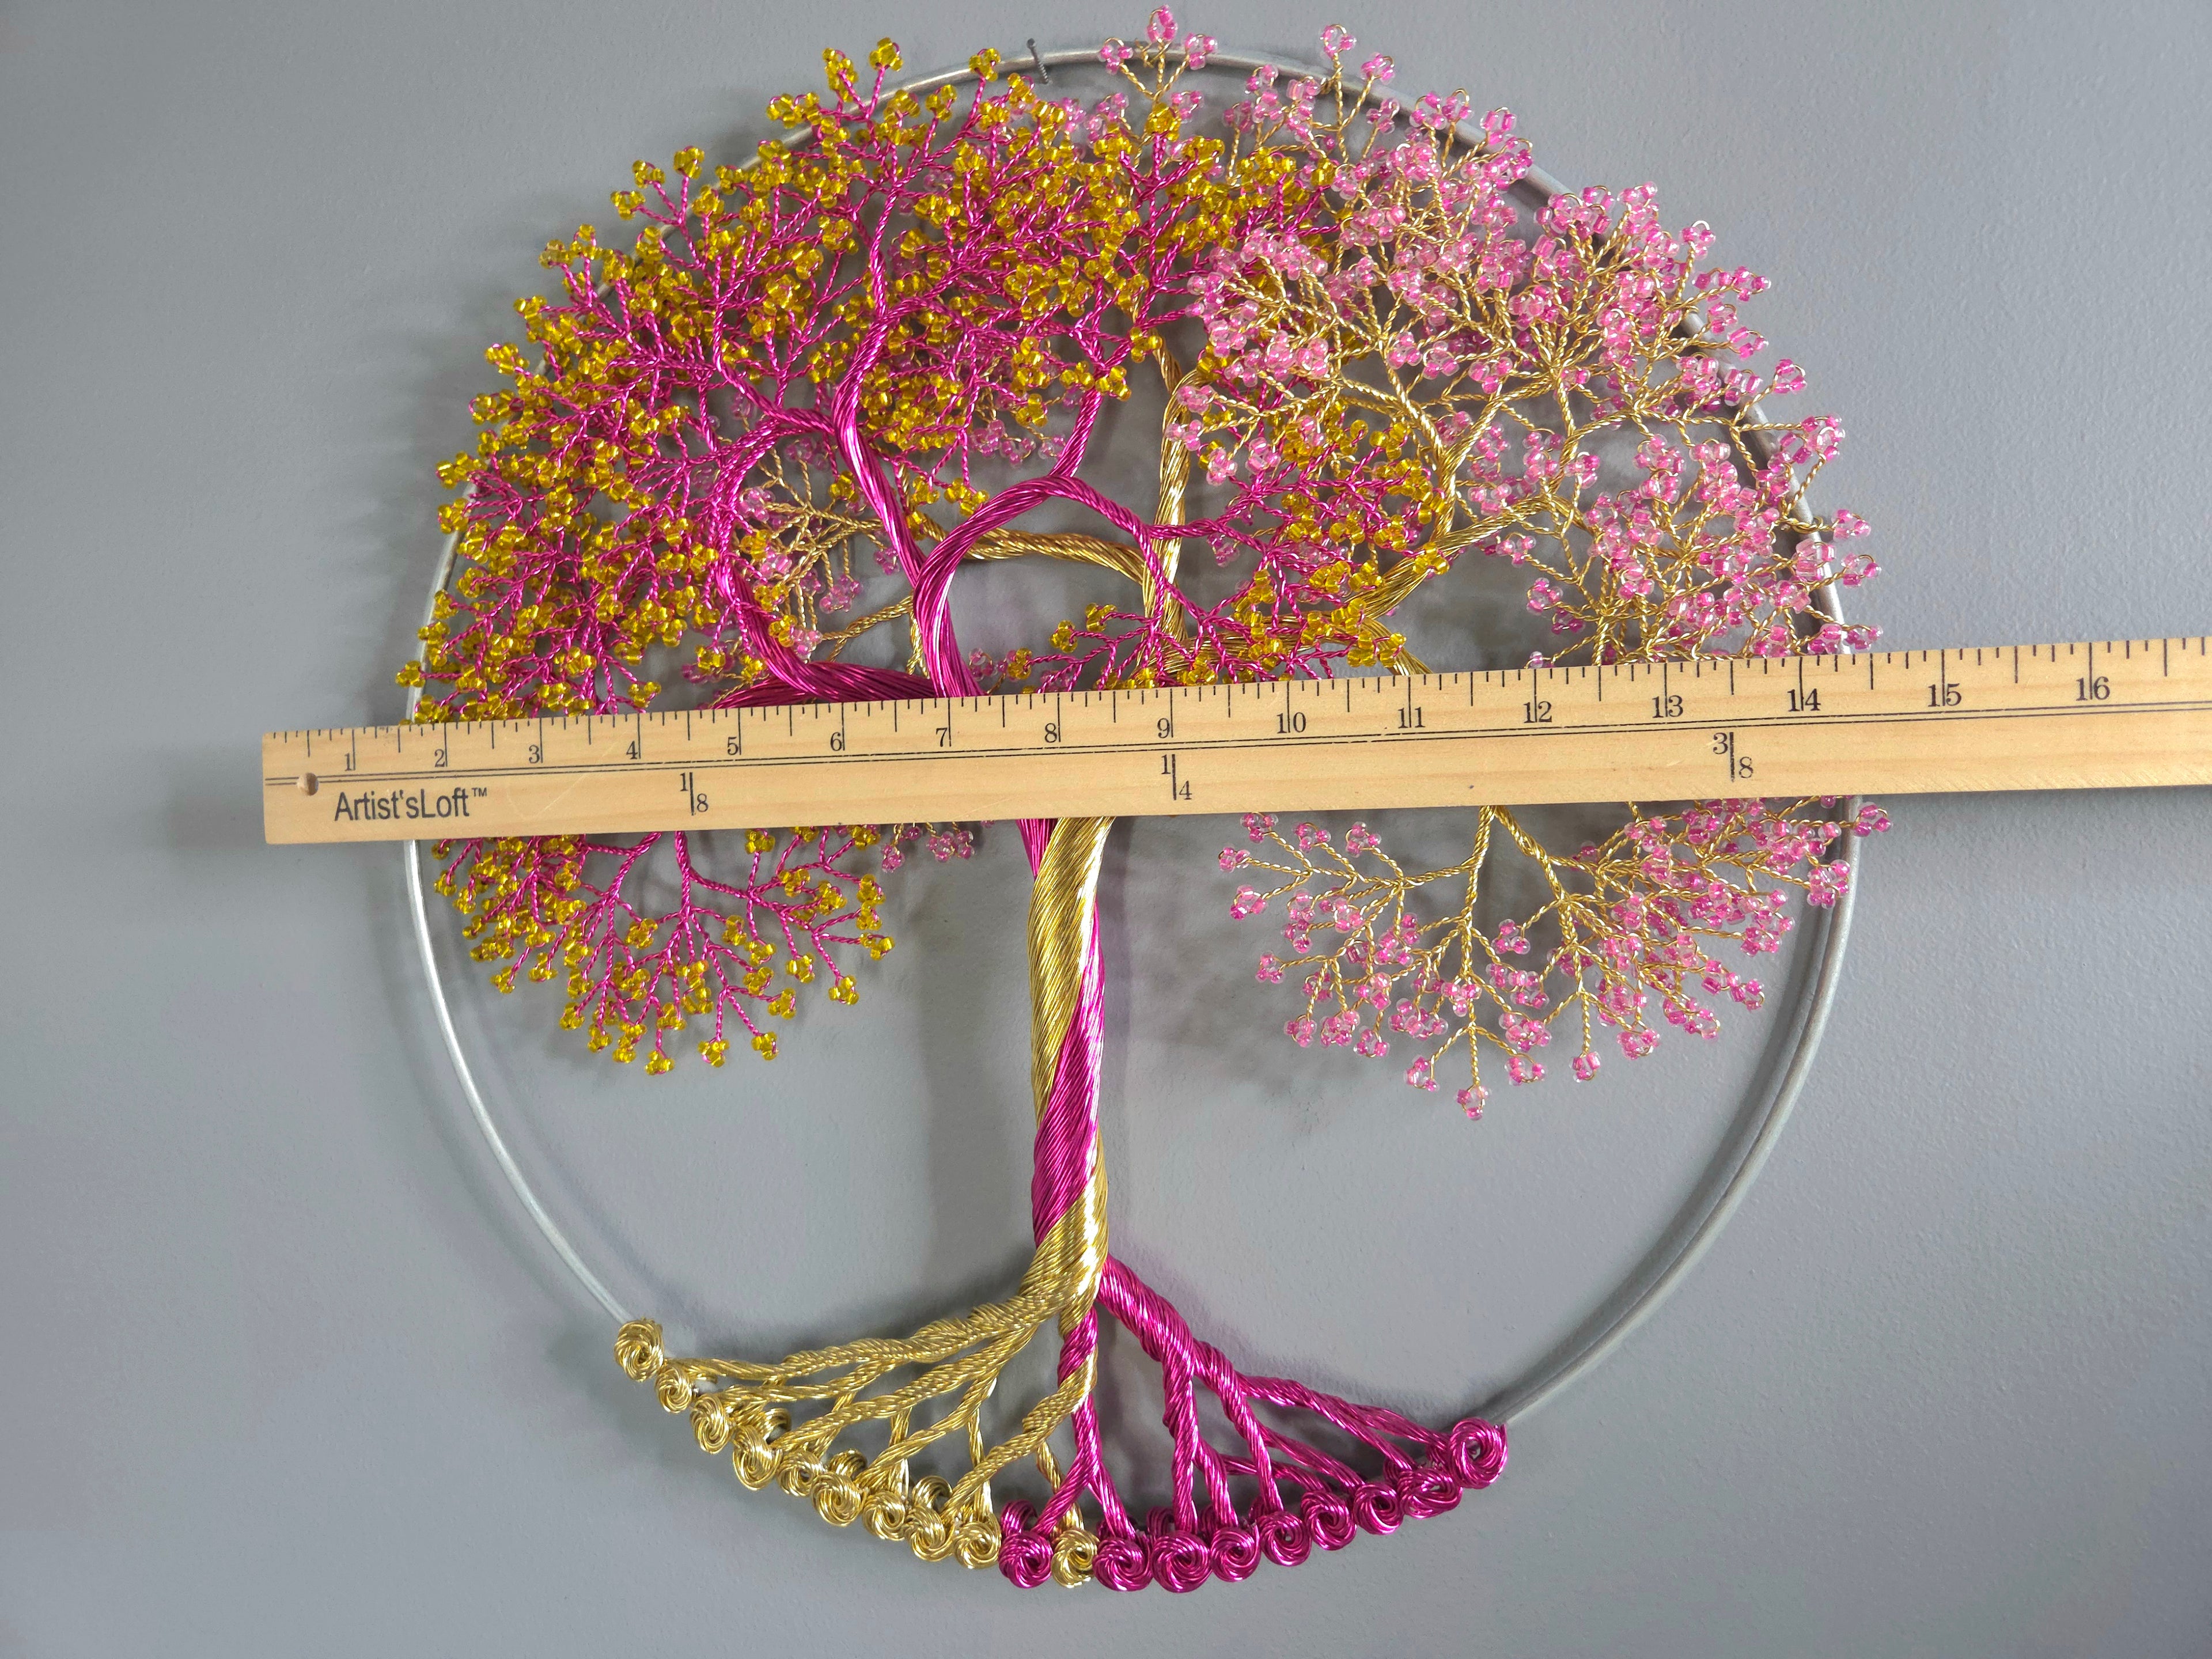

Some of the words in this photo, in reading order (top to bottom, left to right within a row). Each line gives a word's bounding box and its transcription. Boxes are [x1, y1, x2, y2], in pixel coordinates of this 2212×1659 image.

[344, 753, 353, 771] 1
[434, 749, 446, 767] 2
[528, 746, 540, 764] 3
[626, 741, 638, 759] 4
[727, 737, 738, 755] 5
[830, 733, 842, 751] 6
[935, 728, 948, 747] 7
[1044, 724, 1057, 743] 8
[1157, 718, 1170, 738] 9
[1277, 713, 1306, 733] 10
[1398, 707, 1425, 728] 11
[1523, 701, 1552, 724] 12
[1652, 695, 1683, 718] 13
[1788, 688, 1821, 712] 14
[1927, 683, 1962, 707] 15
[2076, 676, 2111, 700] 16
